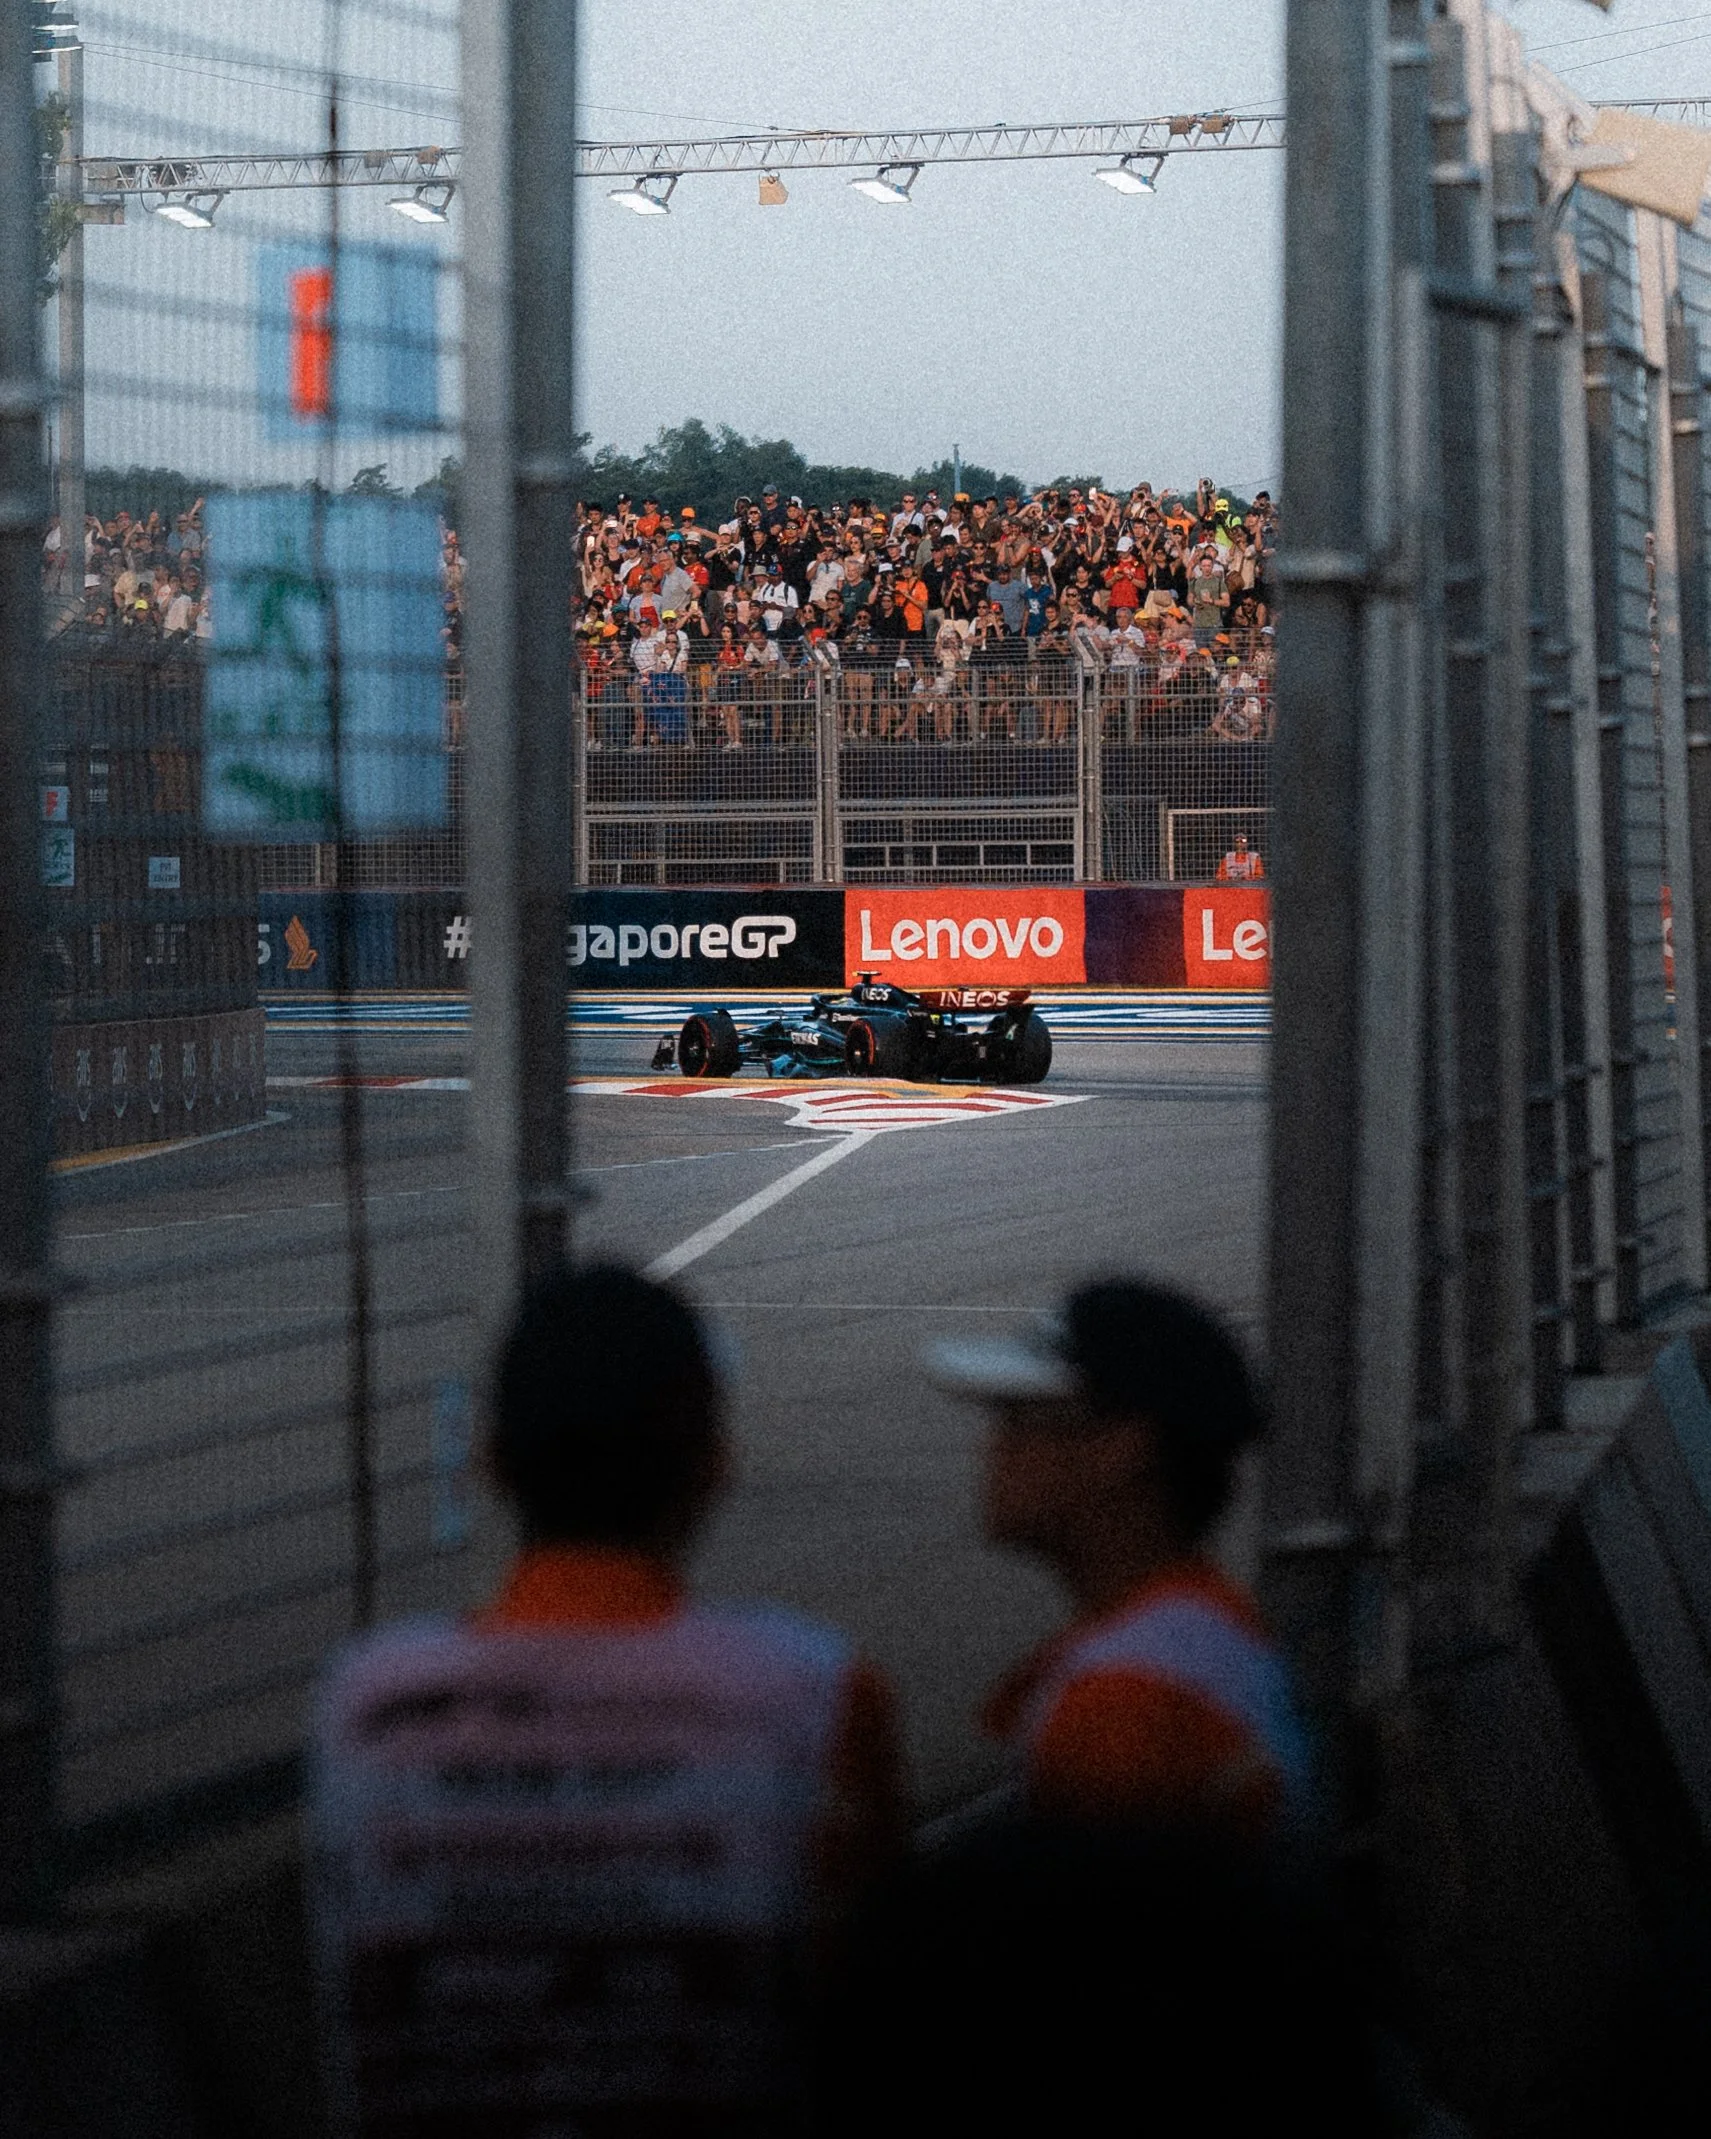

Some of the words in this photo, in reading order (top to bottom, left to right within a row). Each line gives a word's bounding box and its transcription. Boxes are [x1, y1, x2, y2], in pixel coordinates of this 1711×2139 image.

[860, 909, 1064, 961] Lenovo
[1202, 909, 1274, 961] Le
[939, 990, 1012, 1008] INEOS
